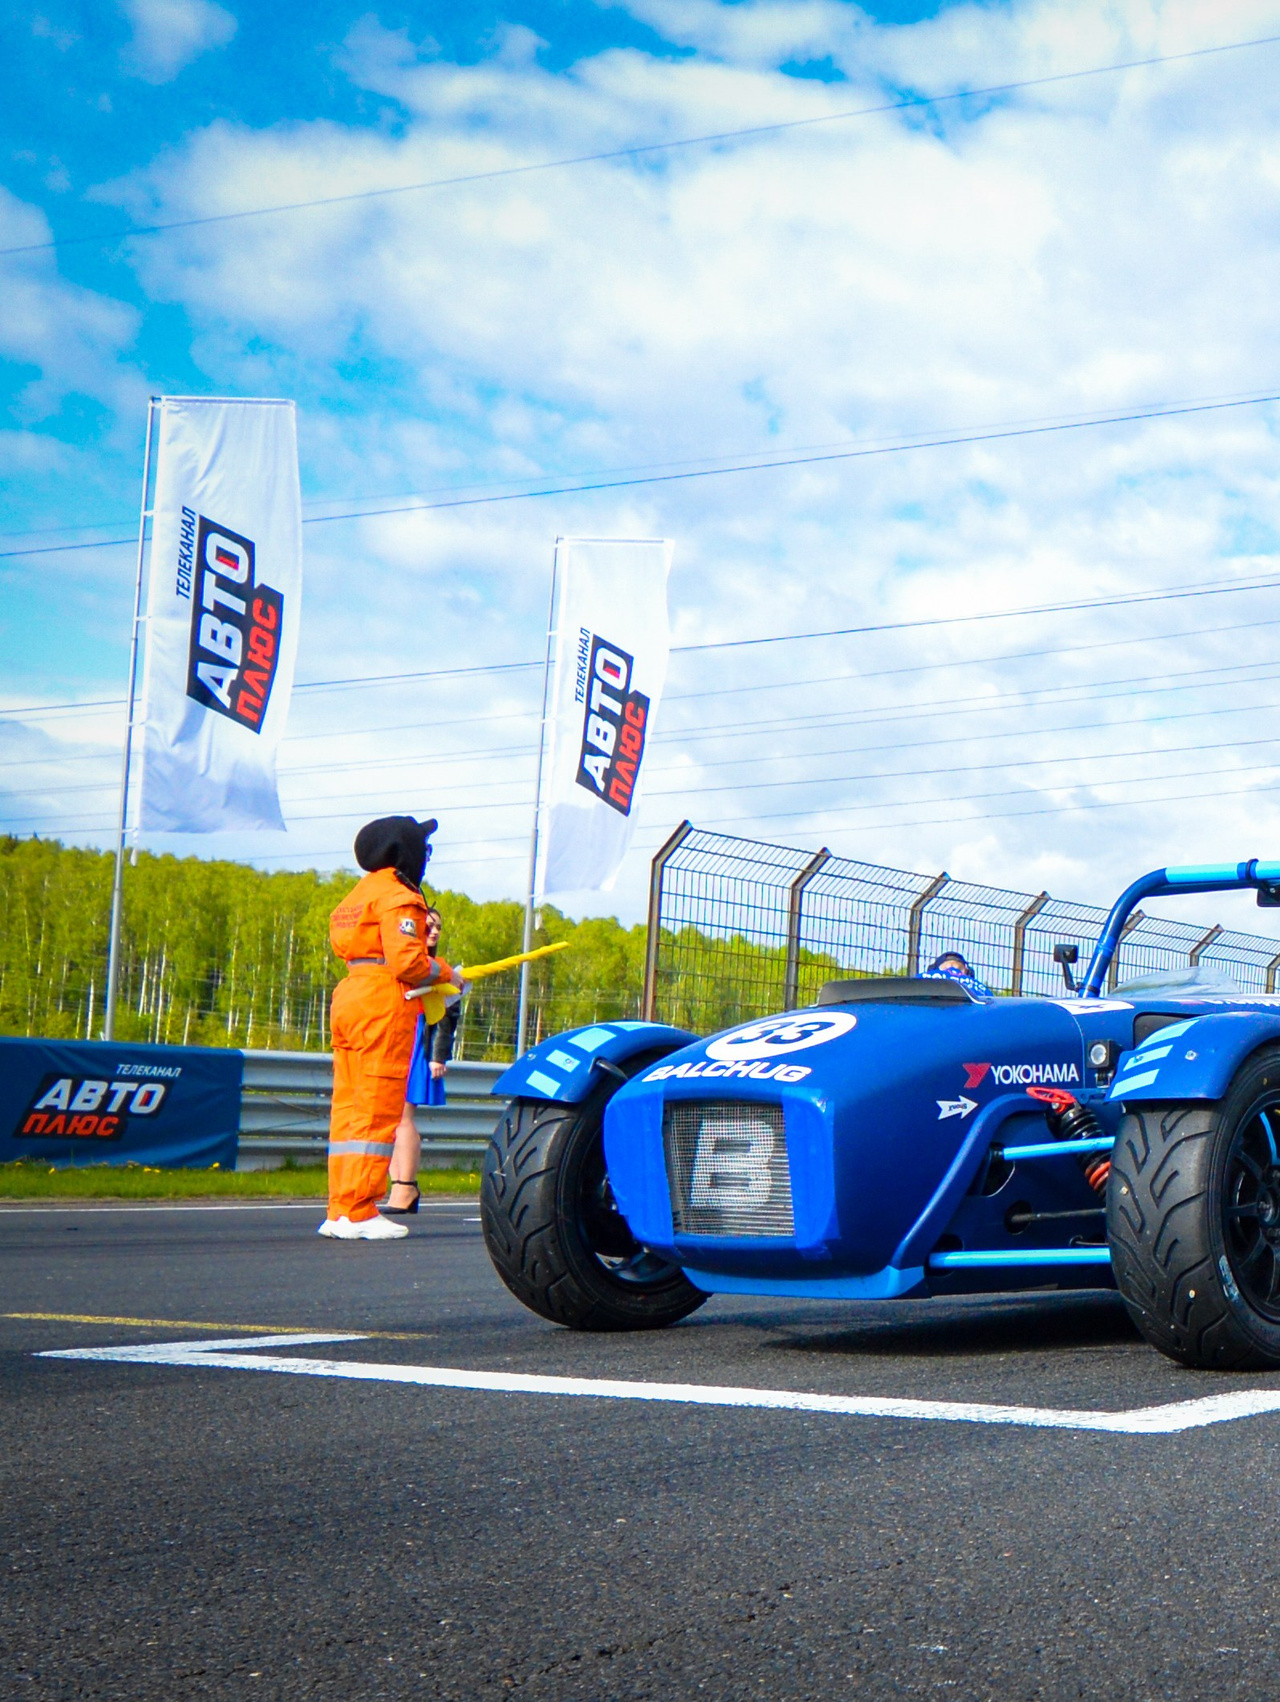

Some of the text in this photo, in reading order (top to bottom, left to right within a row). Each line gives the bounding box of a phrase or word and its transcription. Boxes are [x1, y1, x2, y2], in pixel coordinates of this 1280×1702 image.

[176, 505, 196, 600] ТЕЛЕКАНАЛ
[196, 531, 249, 709] АВТО
[236, 597, 278, 722] ПЛЮС
[574, 626, 591, 704] ТЕЛЕКАНАЛ
[583, 646, 628, 792] АВТО
[609, 701, 645, 807] ПЛЮС
[116, 1063, 182, 1078] ТЕЛЕКАНАЛ
[642, 1060, 813, 1083] BALCHUG
[726, 1021, 836, 1044] 33
[33, 1078, 166, 1115] АВТО
[990, 1063, 1080, 1085] YOKOHAMA
[22, 1113, 120, 1136] ПЛЮС
[690, 1119, 775, 1208] B
